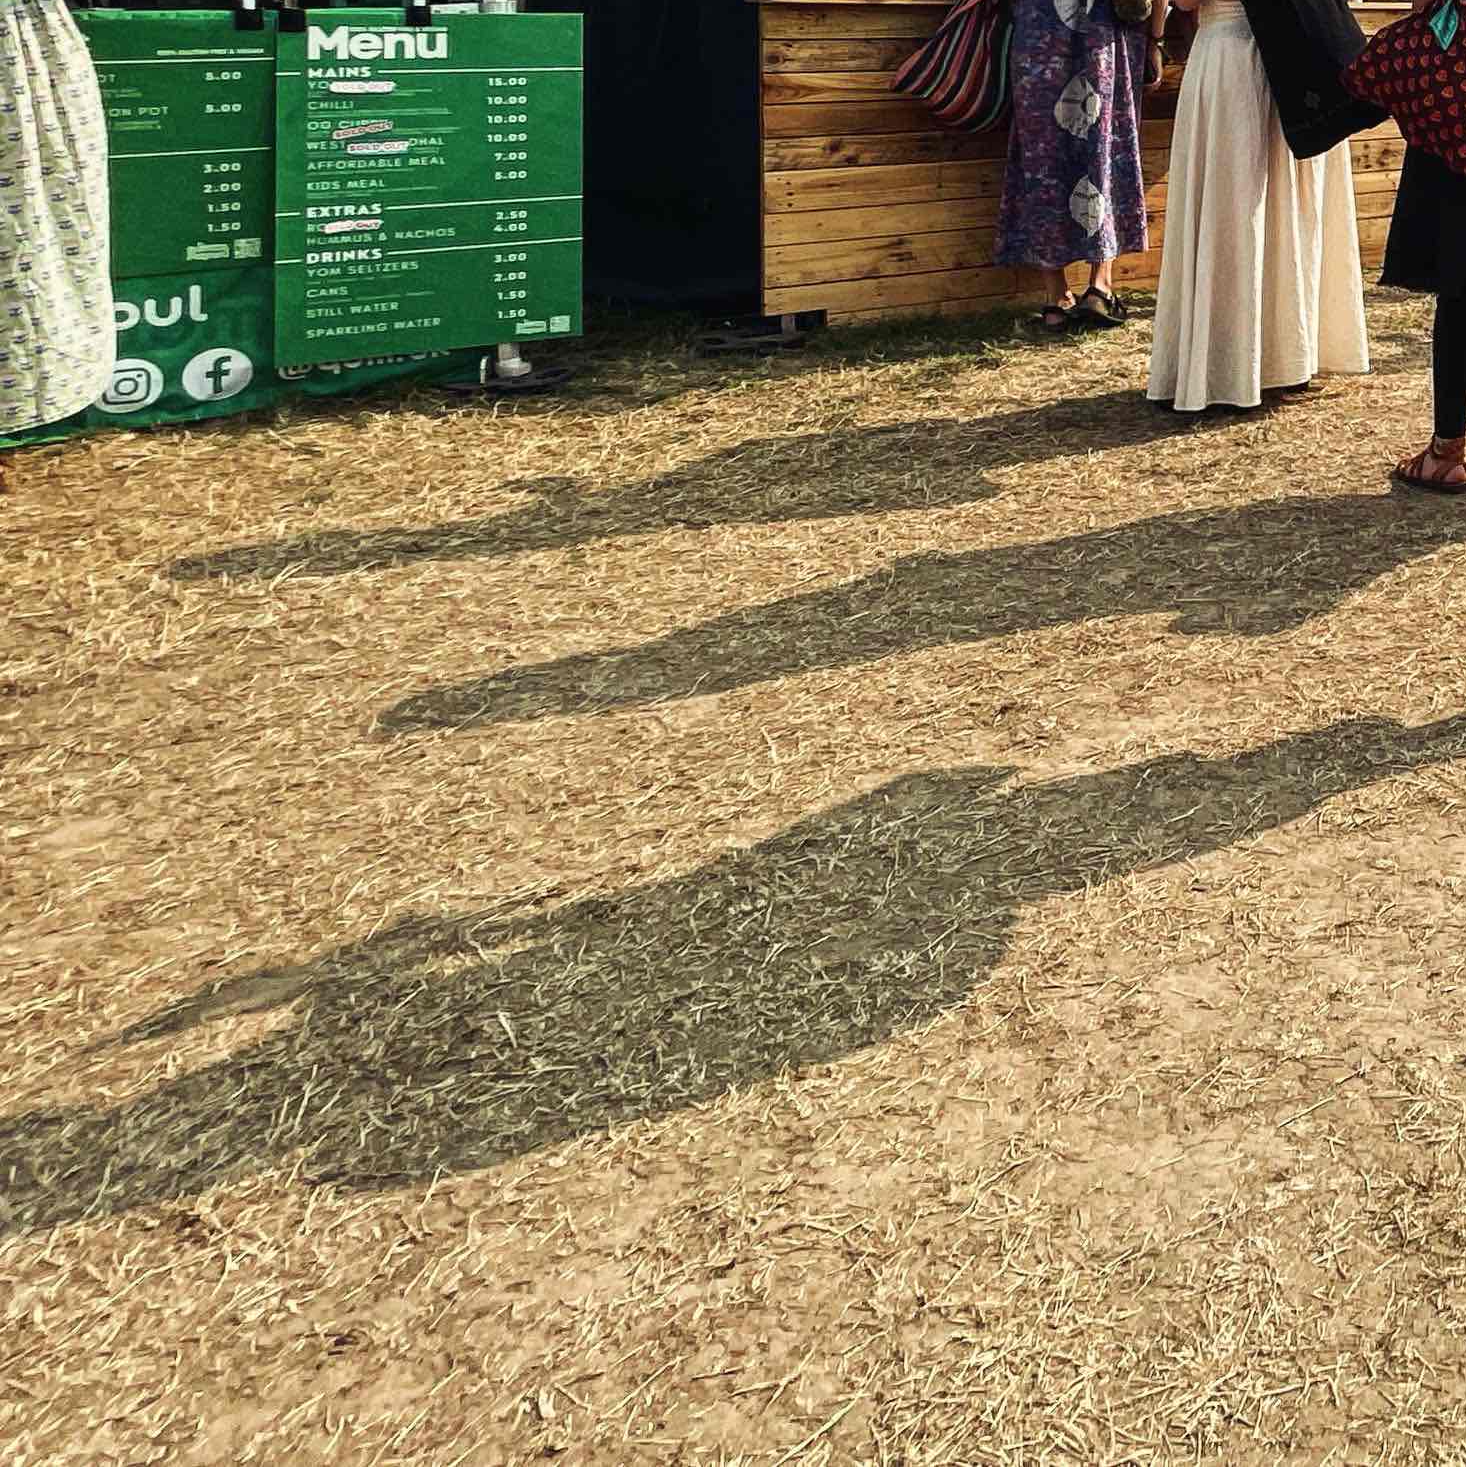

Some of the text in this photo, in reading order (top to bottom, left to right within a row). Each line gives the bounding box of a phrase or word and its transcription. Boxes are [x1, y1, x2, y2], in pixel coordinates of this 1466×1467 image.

[307, 25, 448, 60] Menu
[307, 66, 372, 79] MAINS
[488, 77, 528, 86] 15.00
[307, 100, 354, 110] CHILLI
[486, 95, 528, 105] 10.00
[486, 114, 528, 124] 10.00
[486, 133, 528, 143] 10.00
[306, 156, 446, 171] AFFORDABLE MEAL
[306, 179, 385, 191] KIDS MEAL
[207, 202, 241, 213] 1.50
[306, 203, 382, 219] EXTRAS
[207, 222, 241, 232] 1.50
[394, 227, 456, 239] NACHOS
[306, 248, 382, 264] DRINKS
[306, 261, 419, 278] YOM SELTZERS
[113, 285, 208, 331] oul
[306, 302, 400, 319] STILL WATER
[497, 308, 527, 319] 1.50
[306, 317, 441, 339] SPARKLING WATER
